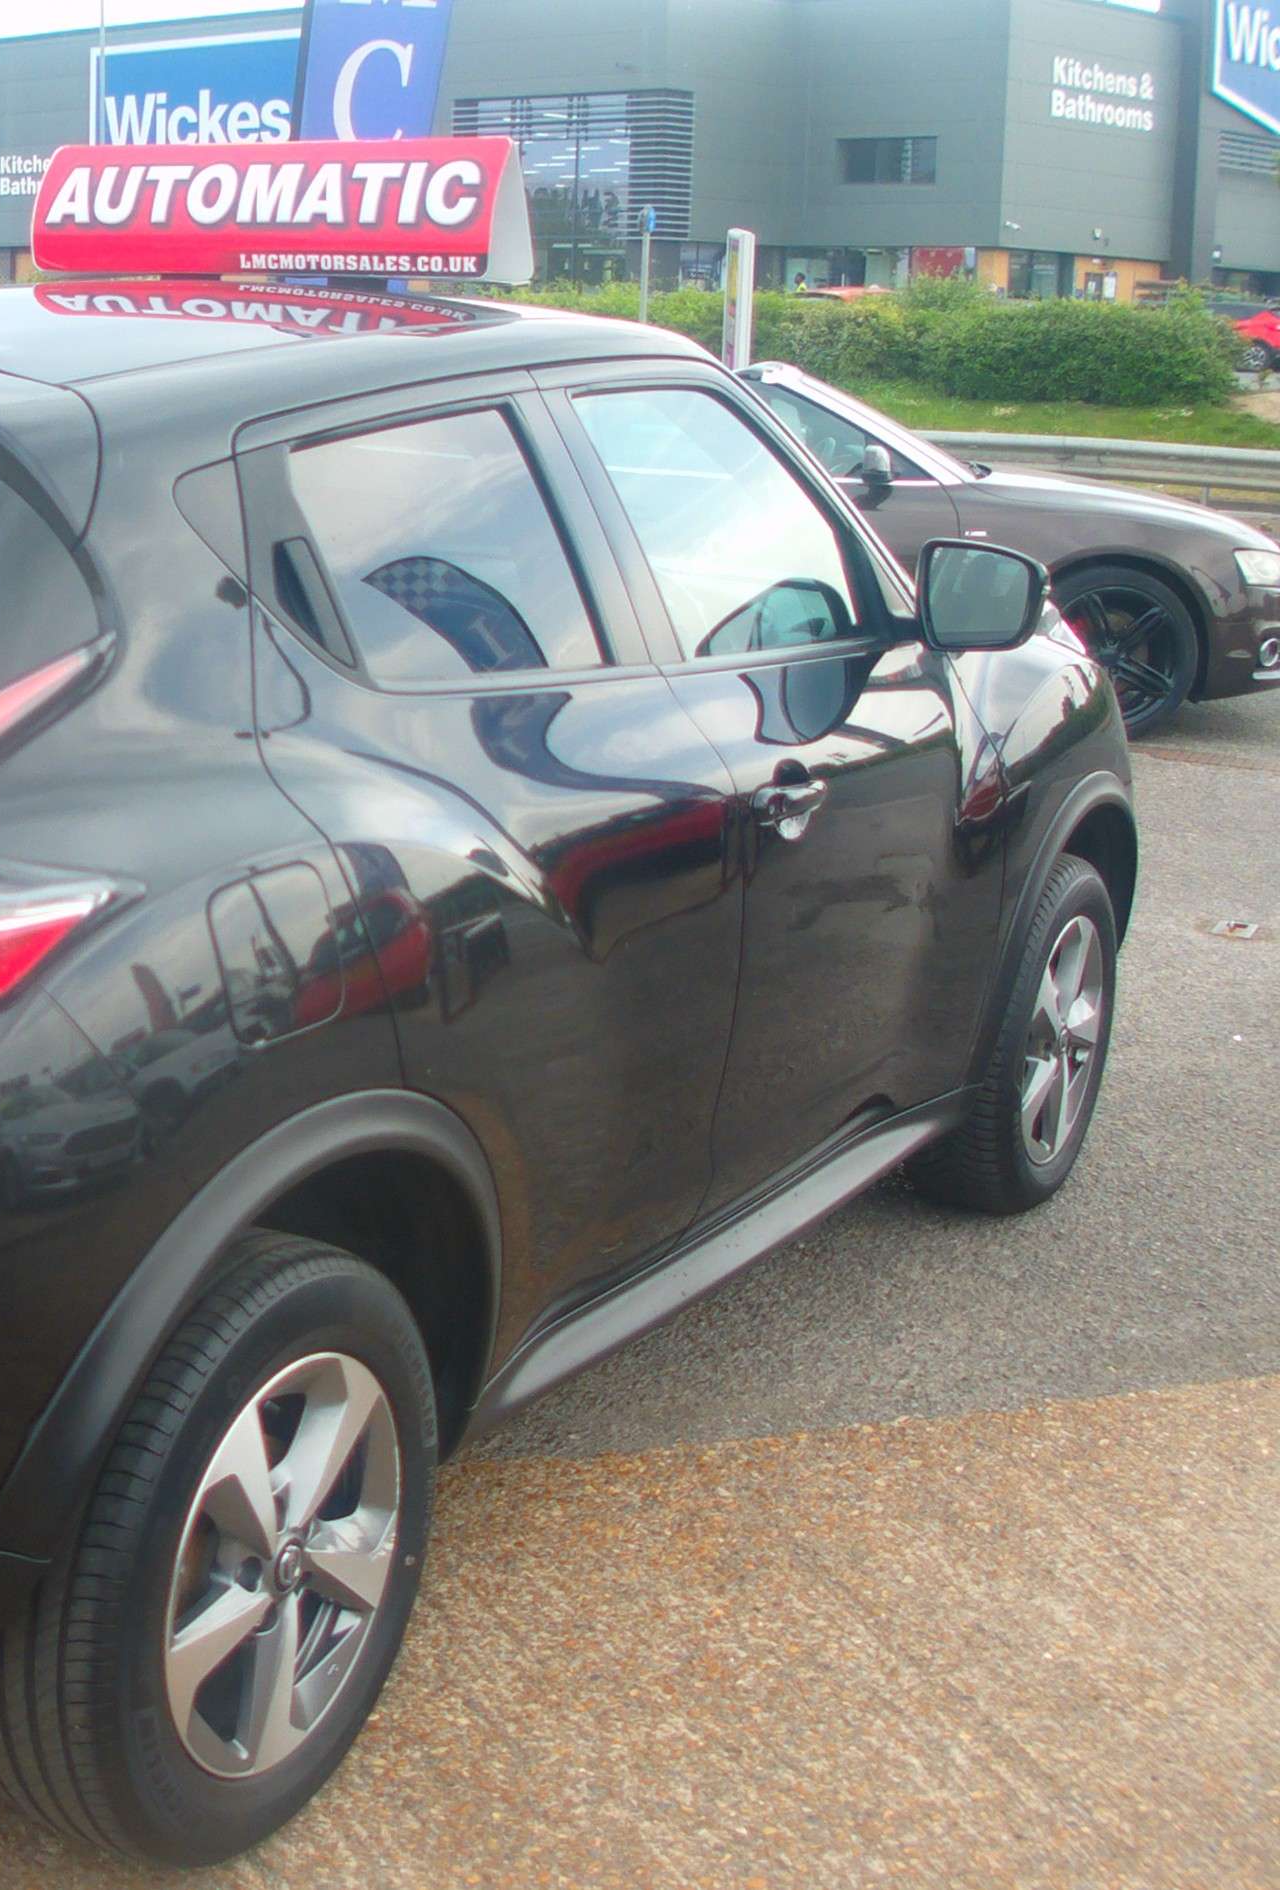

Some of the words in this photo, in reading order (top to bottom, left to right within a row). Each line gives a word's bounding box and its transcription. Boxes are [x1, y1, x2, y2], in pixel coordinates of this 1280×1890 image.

[1053, 56, 1138, 97] Kitchens
[1139, 73, 1154, 100] &
[105, 89, 292, 145] Wickes
[1051, 90, 1154, 132] Bathrooms
[45, 160, 482, 226] AUTOMATIC
[239, 253, 478, 273] LMCMOTORSALES.CO.UK
